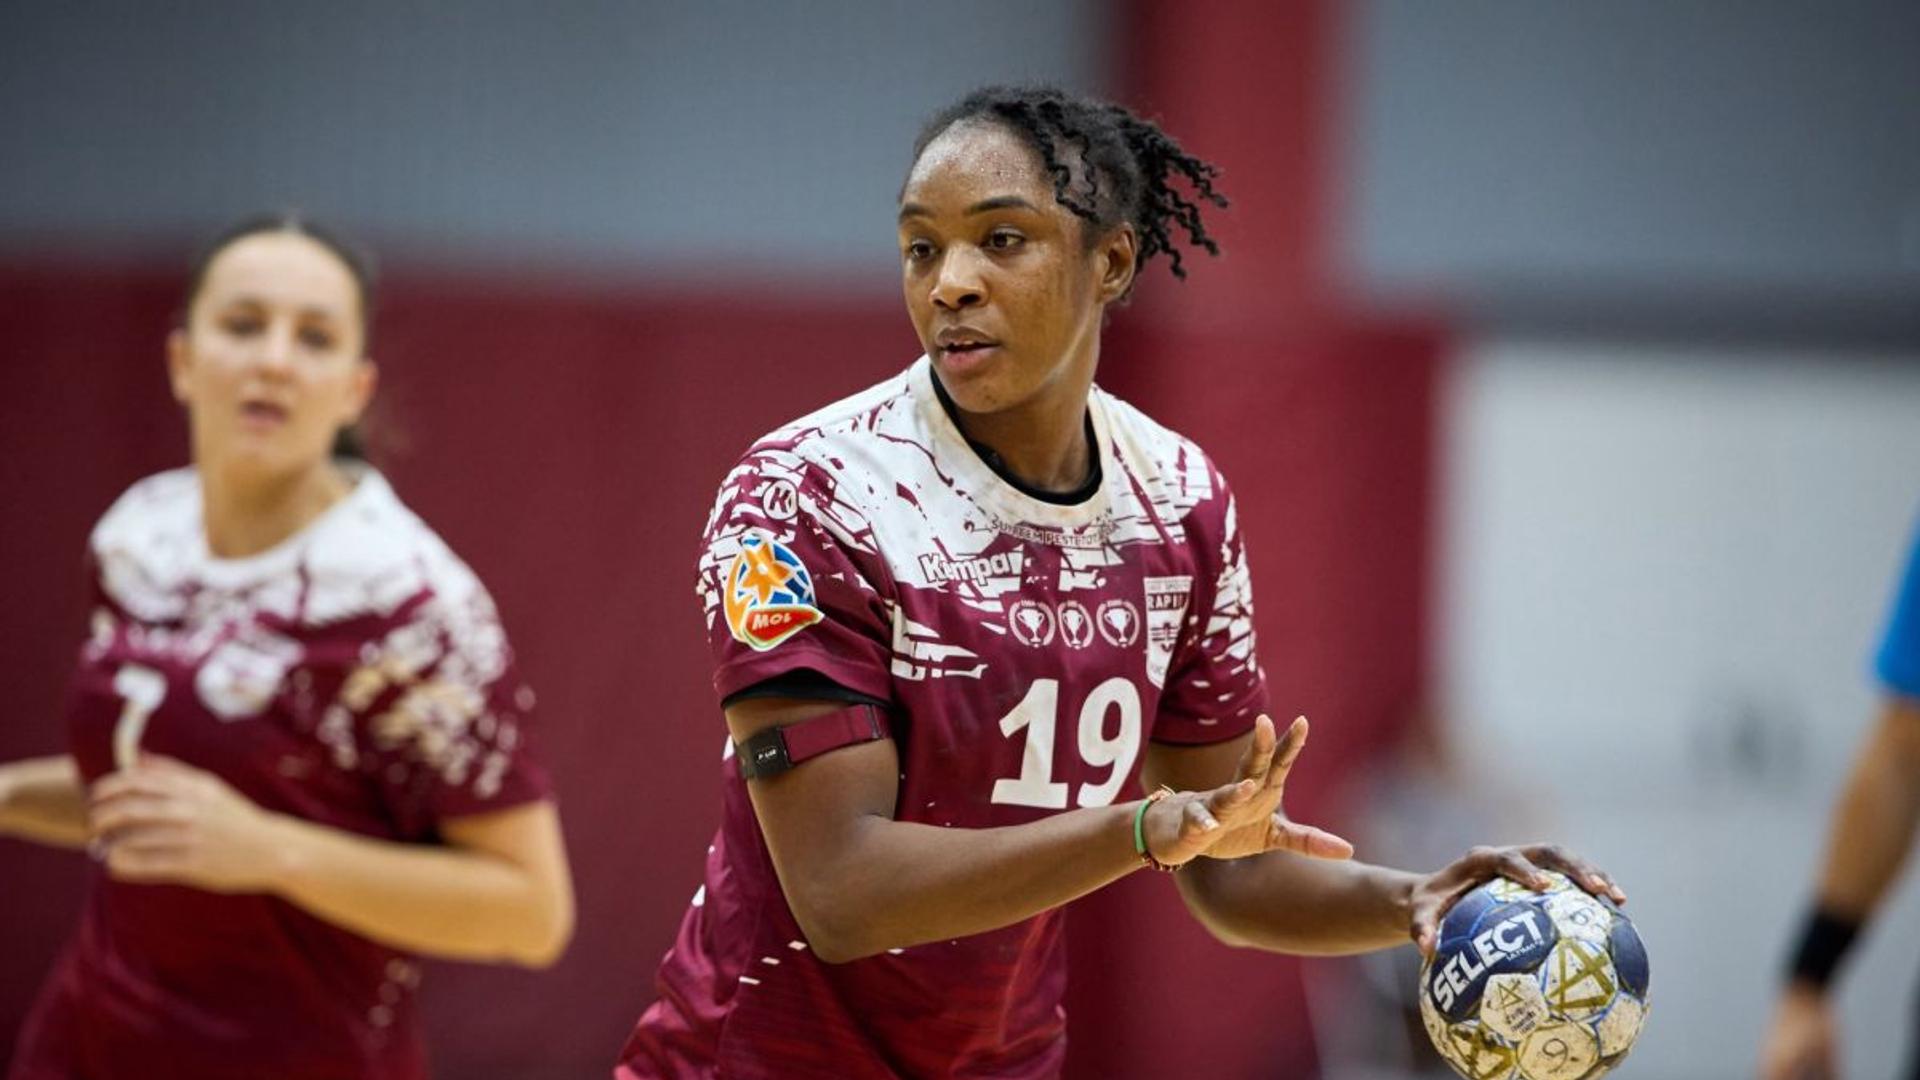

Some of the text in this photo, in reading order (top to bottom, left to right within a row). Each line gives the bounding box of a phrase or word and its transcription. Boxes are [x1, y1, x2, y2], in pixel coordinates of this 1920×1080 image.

[752, 611, 792, 630] MOL
[114, 664, 166, 769] 7
[990, 677, 1142, 808] 19
[1433, 910, 1545, 1013] SELECT
